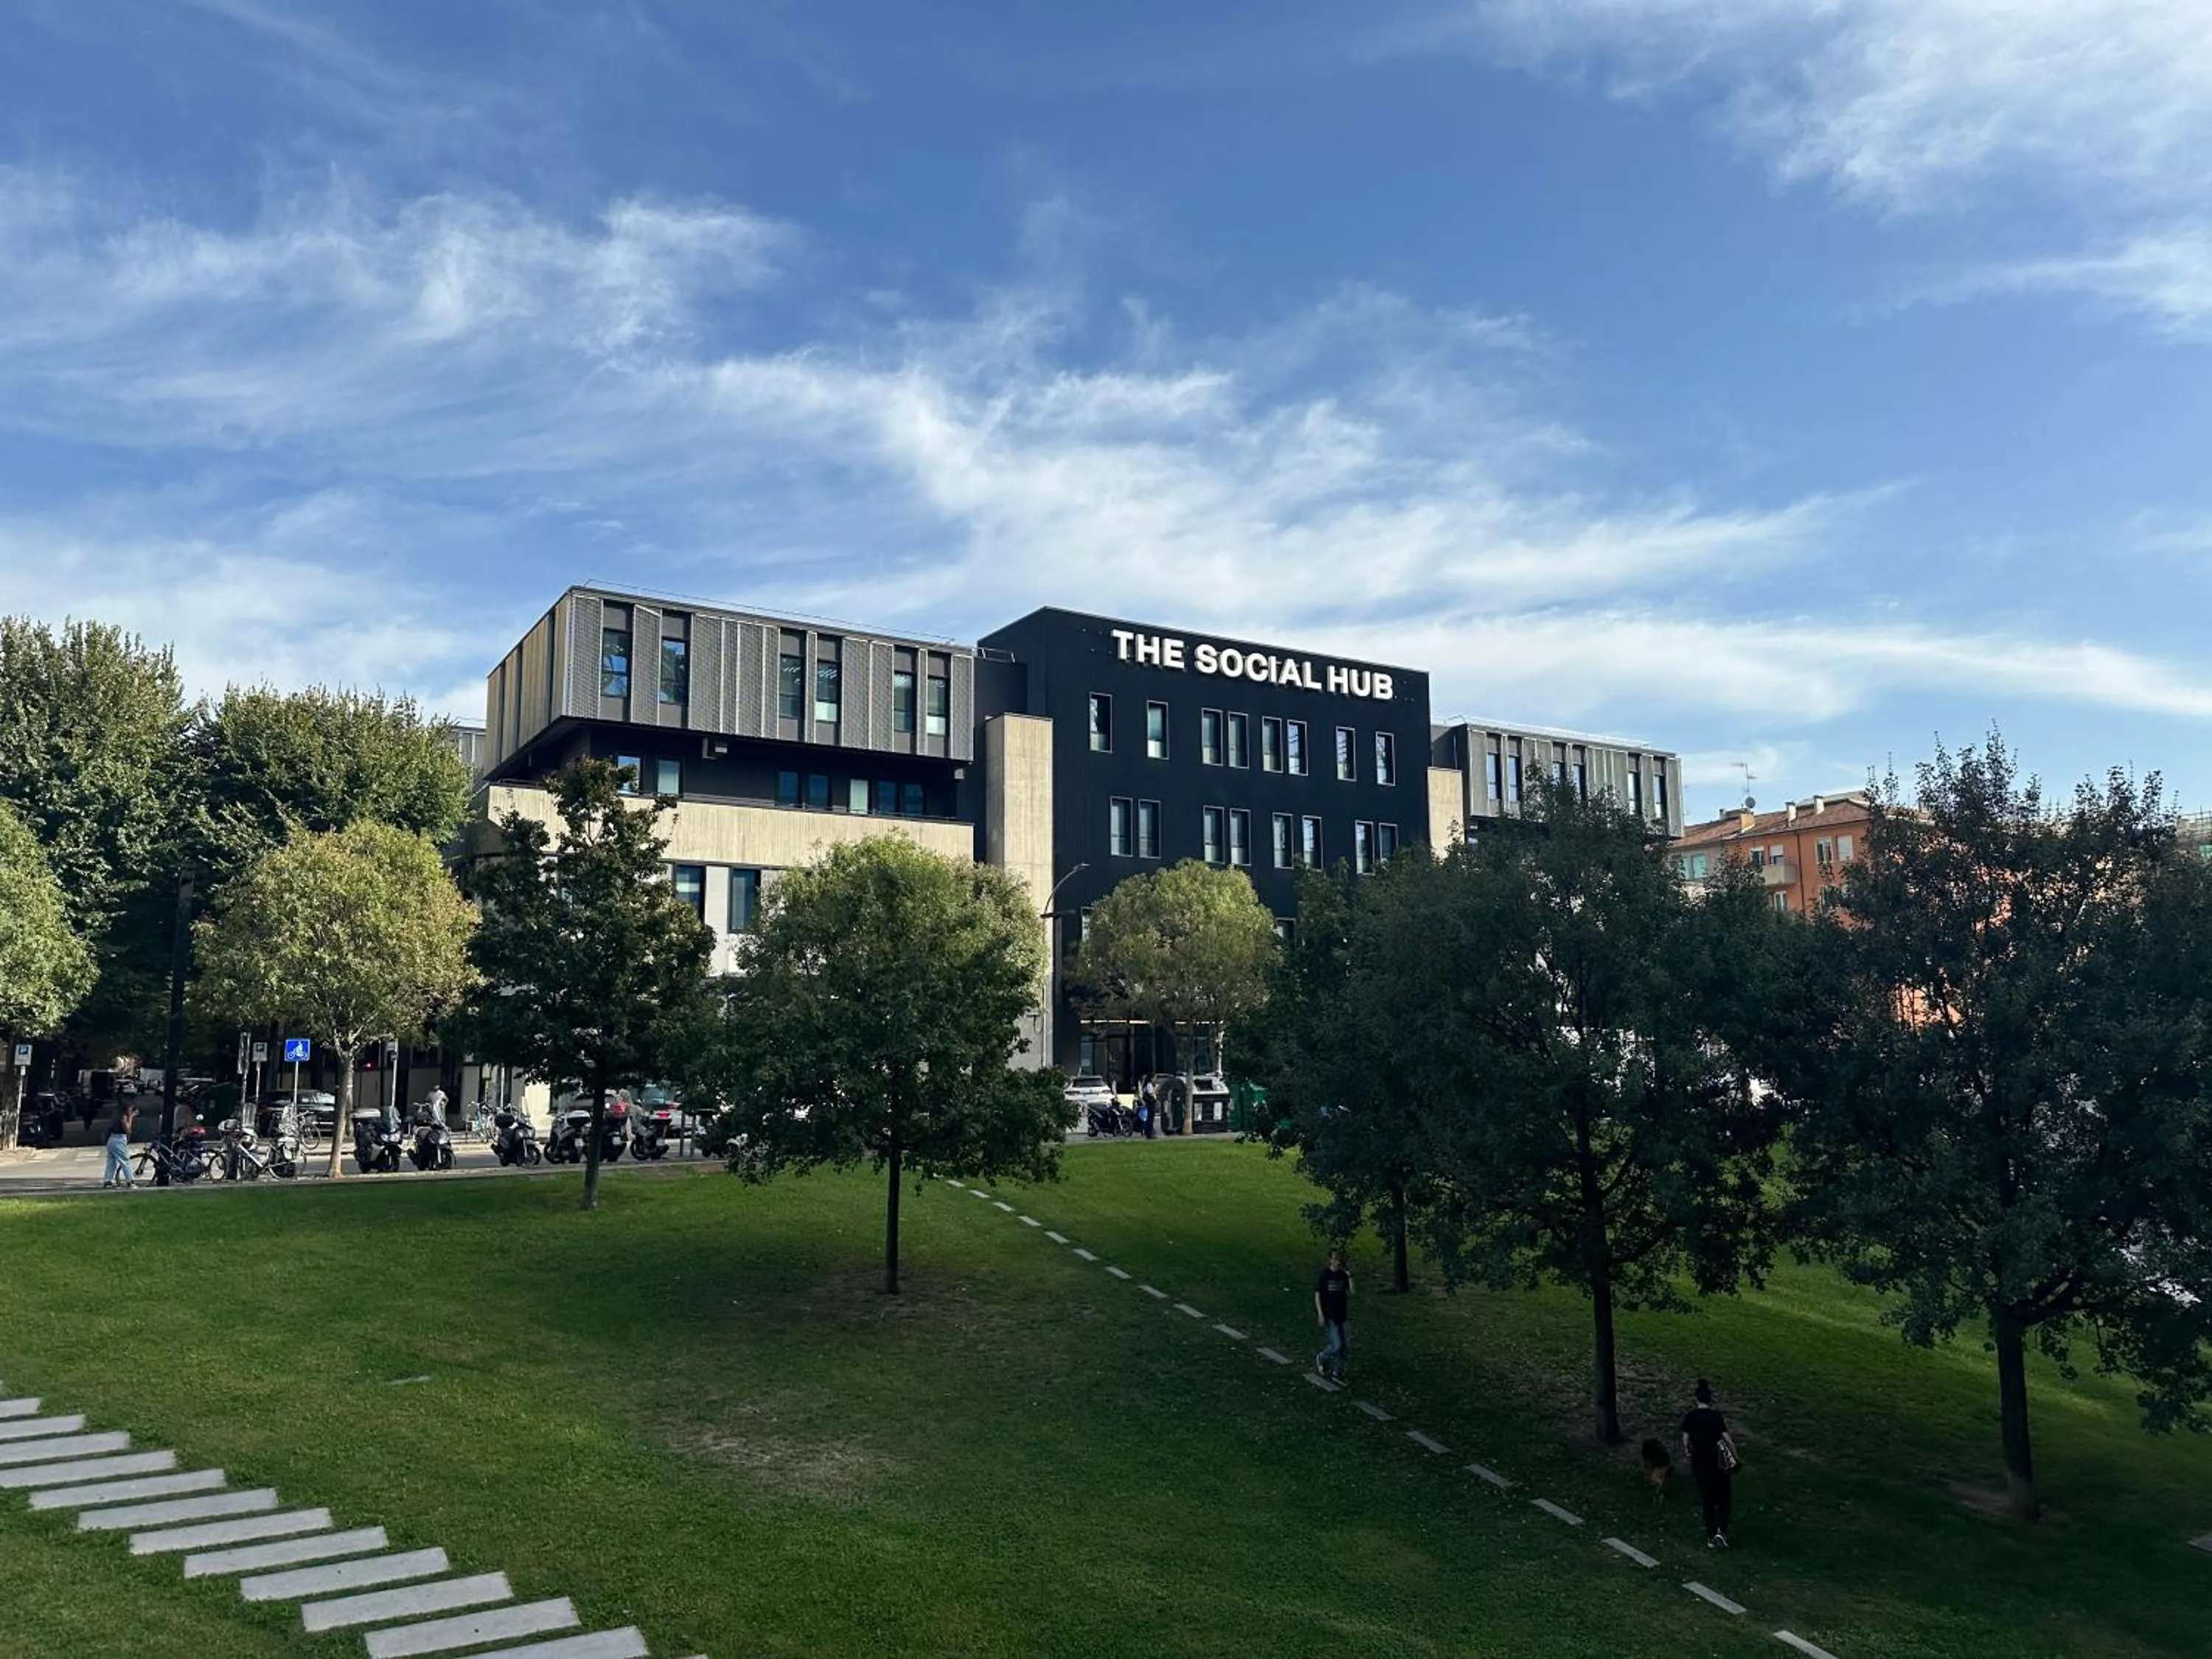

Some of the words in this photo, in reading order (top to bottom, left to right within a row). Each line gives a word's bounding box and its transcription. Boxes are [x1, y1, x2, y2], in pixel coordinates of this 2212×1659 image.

[1111, 629, 1185, 669] THE
[1194, 643, 1322, 690] SOCIAL
[1329, 665, 1394, 700] HUB
